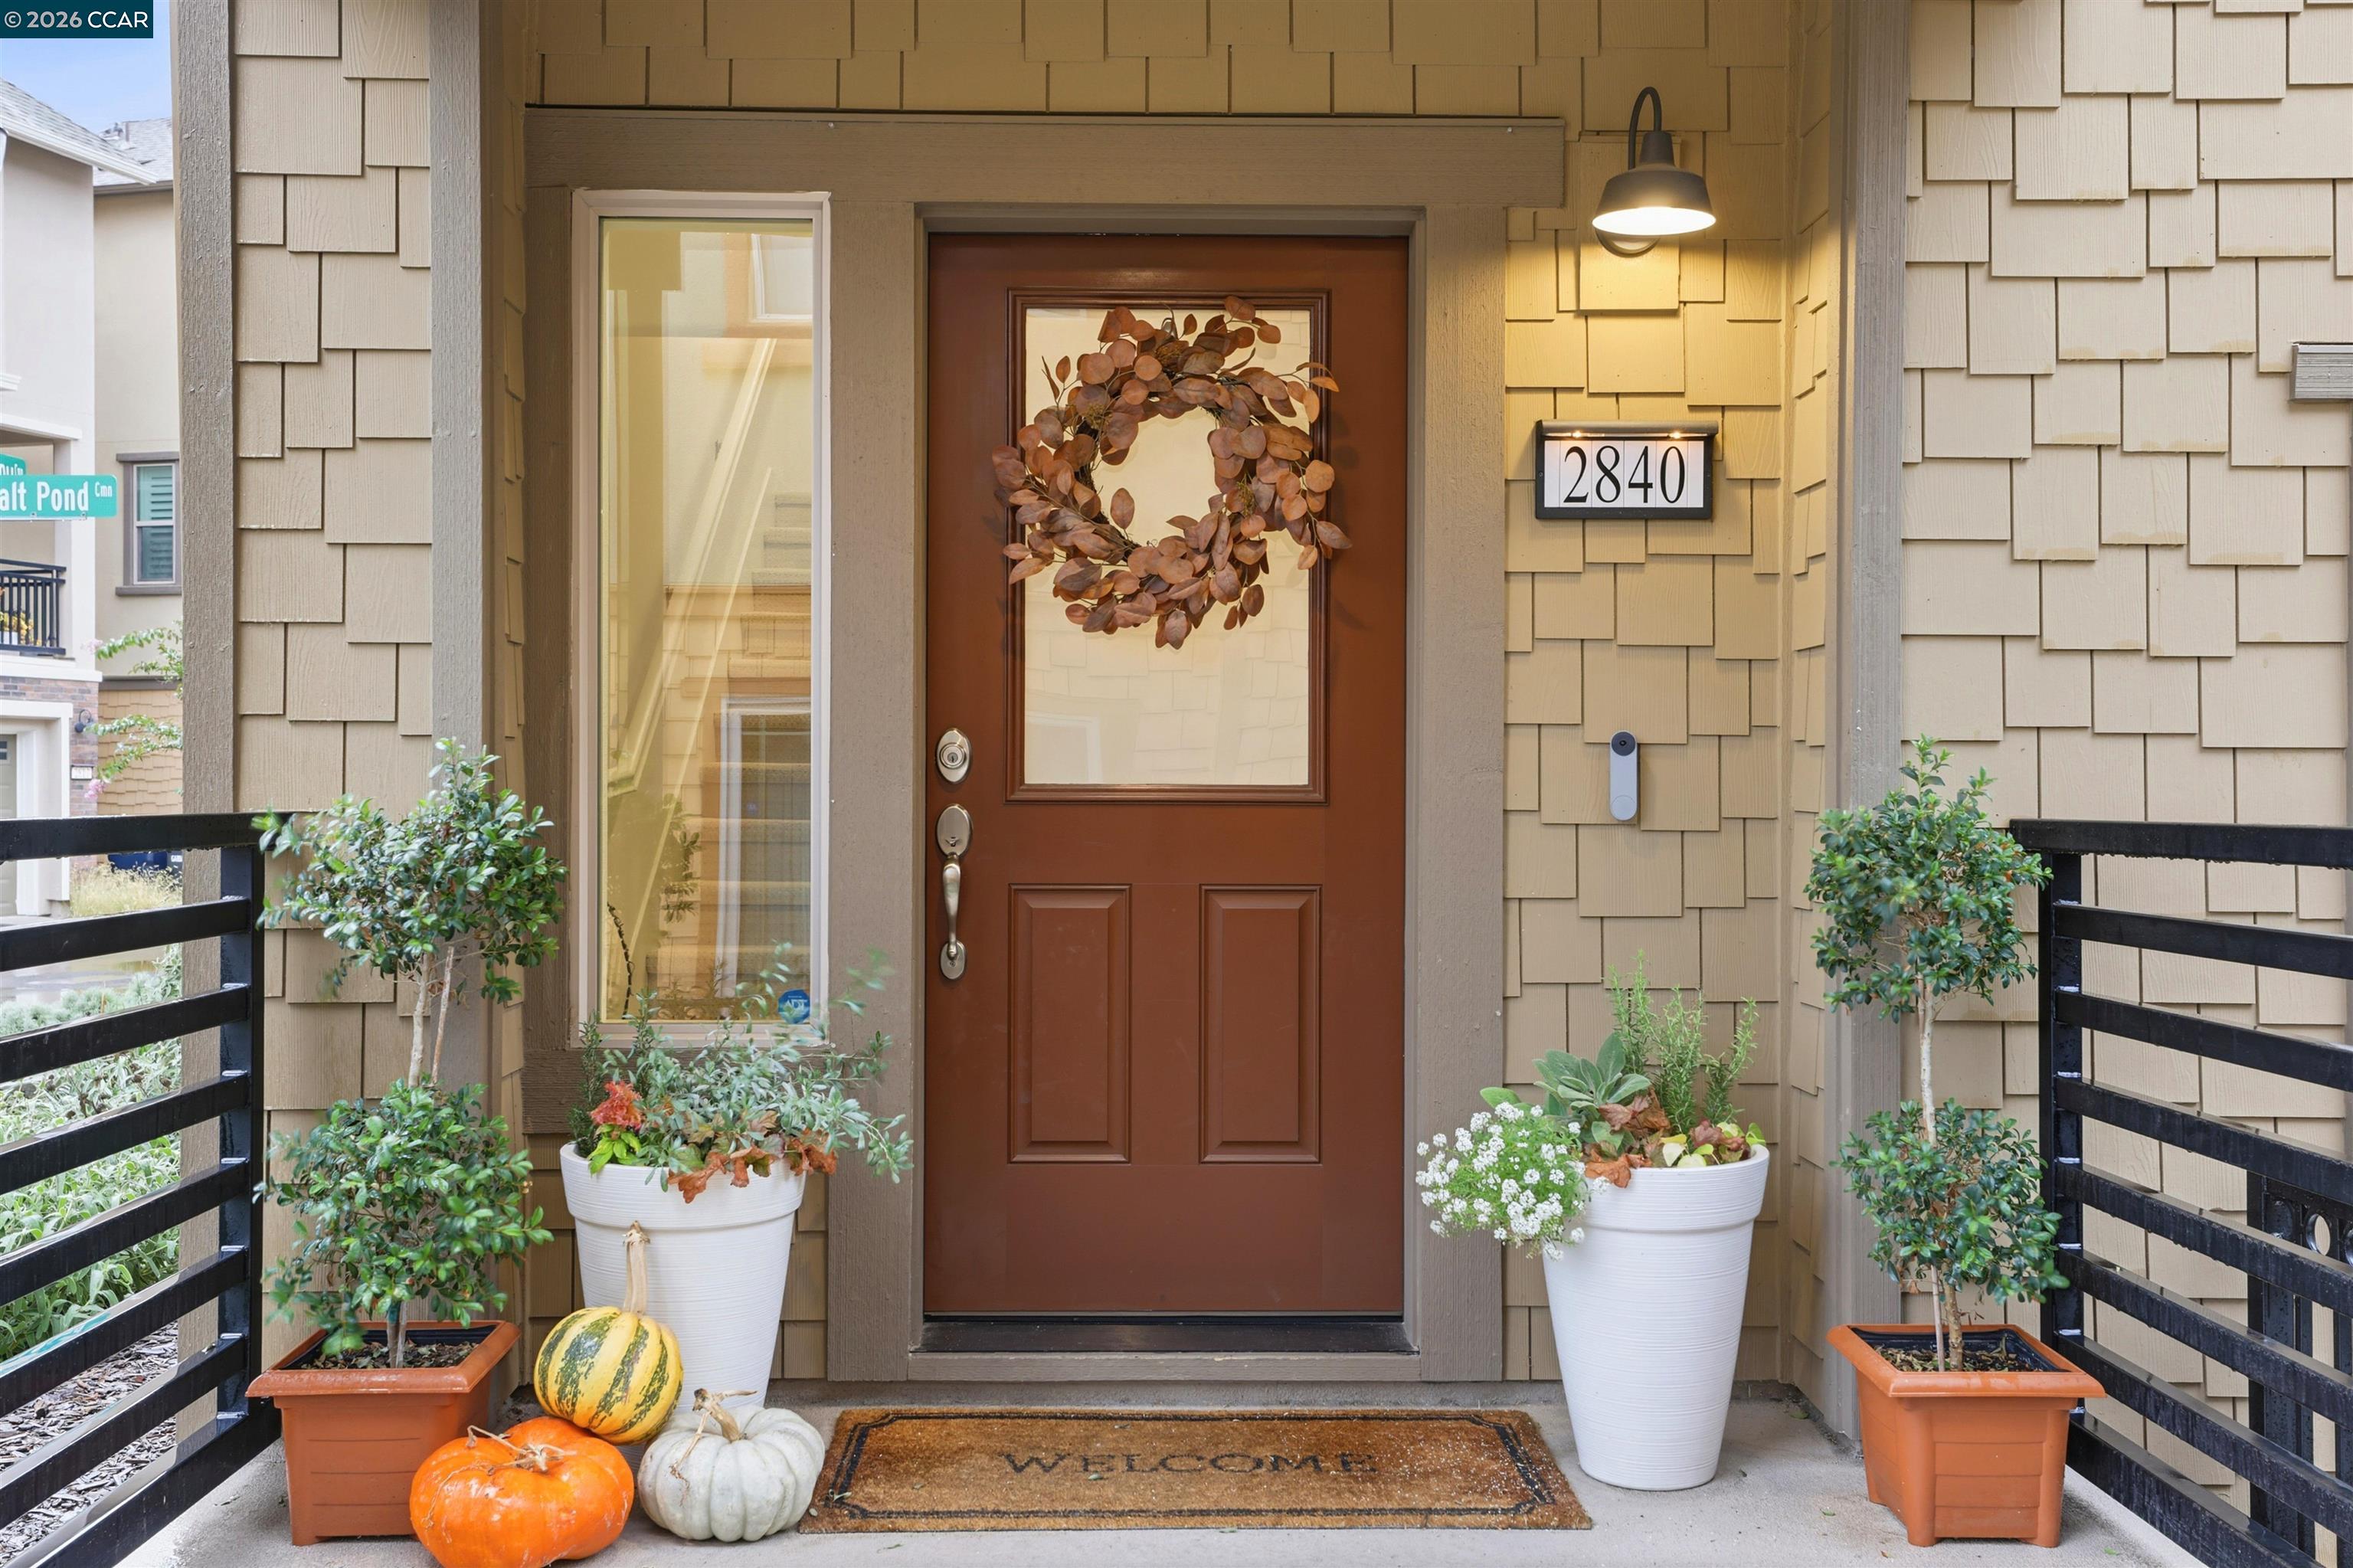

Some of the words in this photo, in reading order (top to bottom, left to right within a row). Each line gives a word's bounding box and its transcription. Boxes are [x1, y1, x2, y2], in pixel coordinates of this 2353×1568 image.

[1563, 445, 1685, 503] 2840
[37, 480, 89, 512] Pond
[94, 481, 113, 497] Cmn
[997, 1452, 1379, 1474] WELCOME
